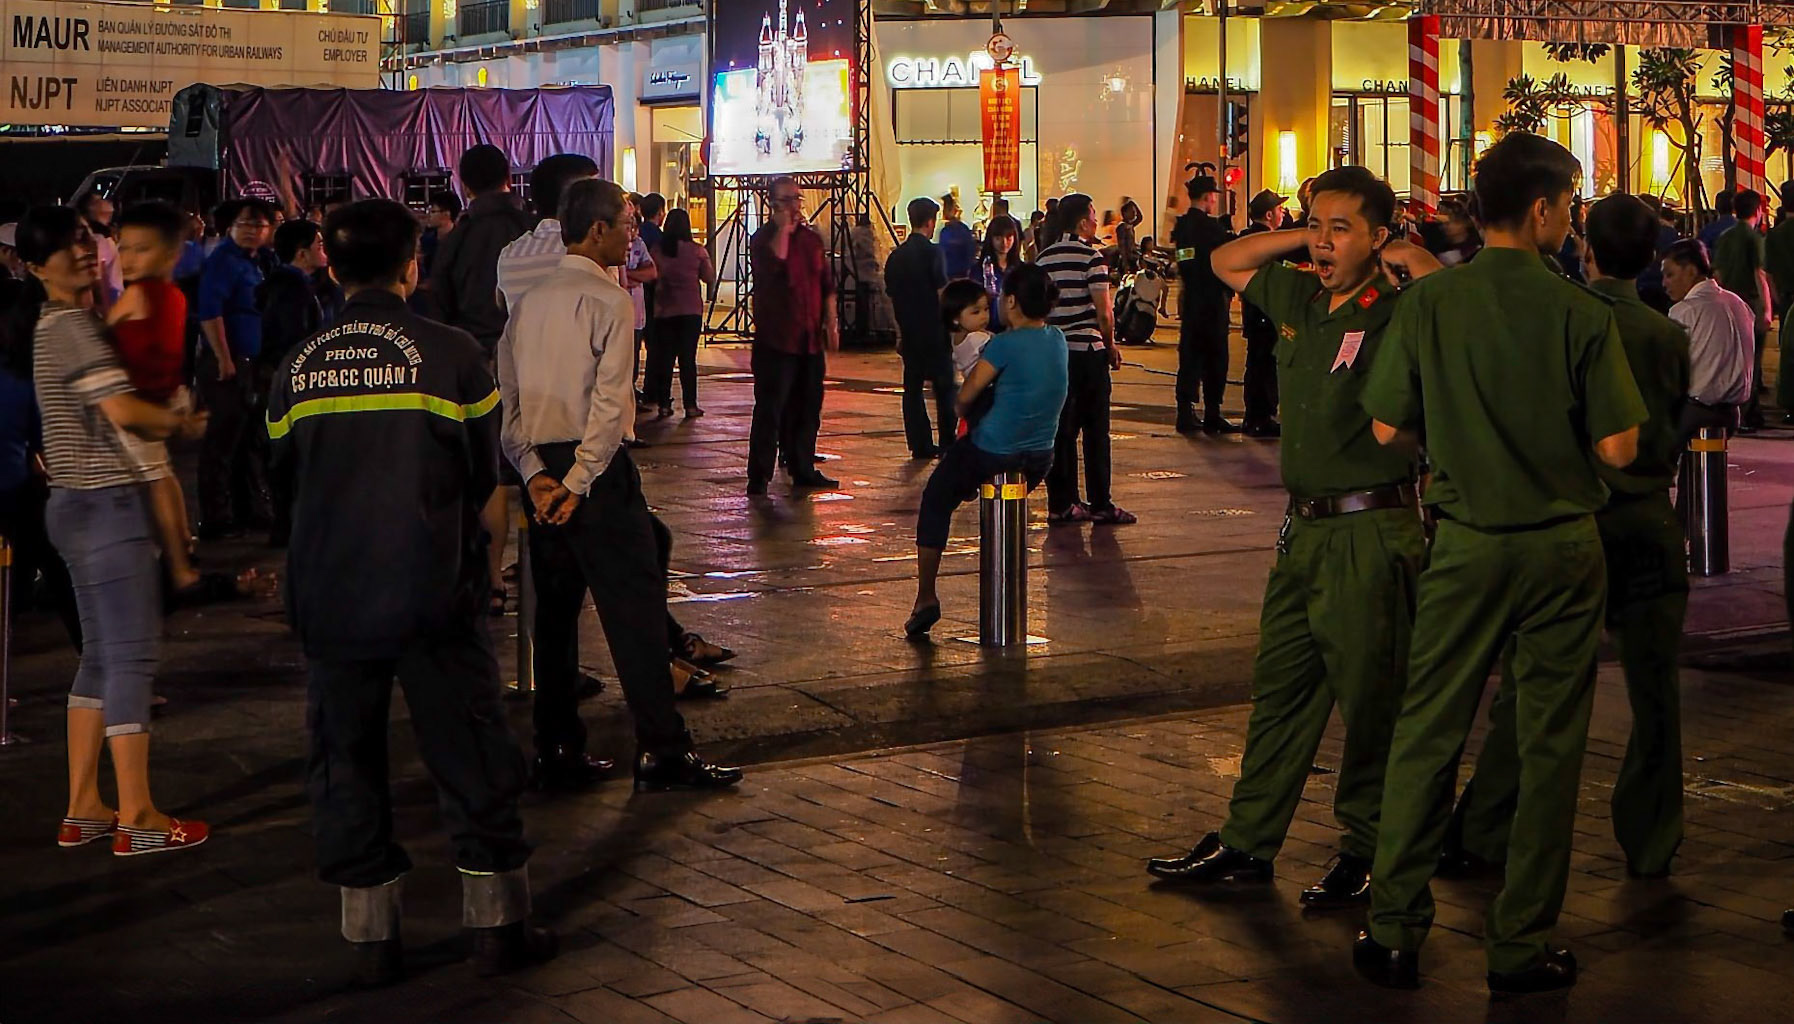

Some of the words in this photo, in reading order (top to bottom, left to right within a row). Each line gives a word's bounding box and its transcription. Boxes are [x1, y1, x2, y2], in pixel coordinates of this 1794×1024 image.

[13, 15, 90, 51] MAUR
[98, 20, 116, 33] BAN
[97, 39, 155, 54] MANAGEMENT
[156, 41, 201, 56] AUTHORITY
[202, 44, 218, 57] FOR
[219, 45, 245, 59] URBAN
[246, 46, 283, 60] RAILWAYS
[323, 48, 368, 63] EMPLOYER
[890, 58, 1039, 84] CHAL
[120, 79, 147, 93] DANH
[149, 80, 174, 94] NJPT
[1186, 76, 1247, 91] HANEL
[1362, 79, 1409, 93] CHAN
[10, 76, 77, 110] NJPT
[94, 98, 121, 112] NJPT
[121, 98, 173, 113] ASSOCIATI
[325, 346, 379, 361] PHÒNG
[291, 373, 306, 393] CS
[309, 368, 359, 389] PC&CC
[363, 363, 406, 388] QUẬN
[410, 367, 418, 384] 1
